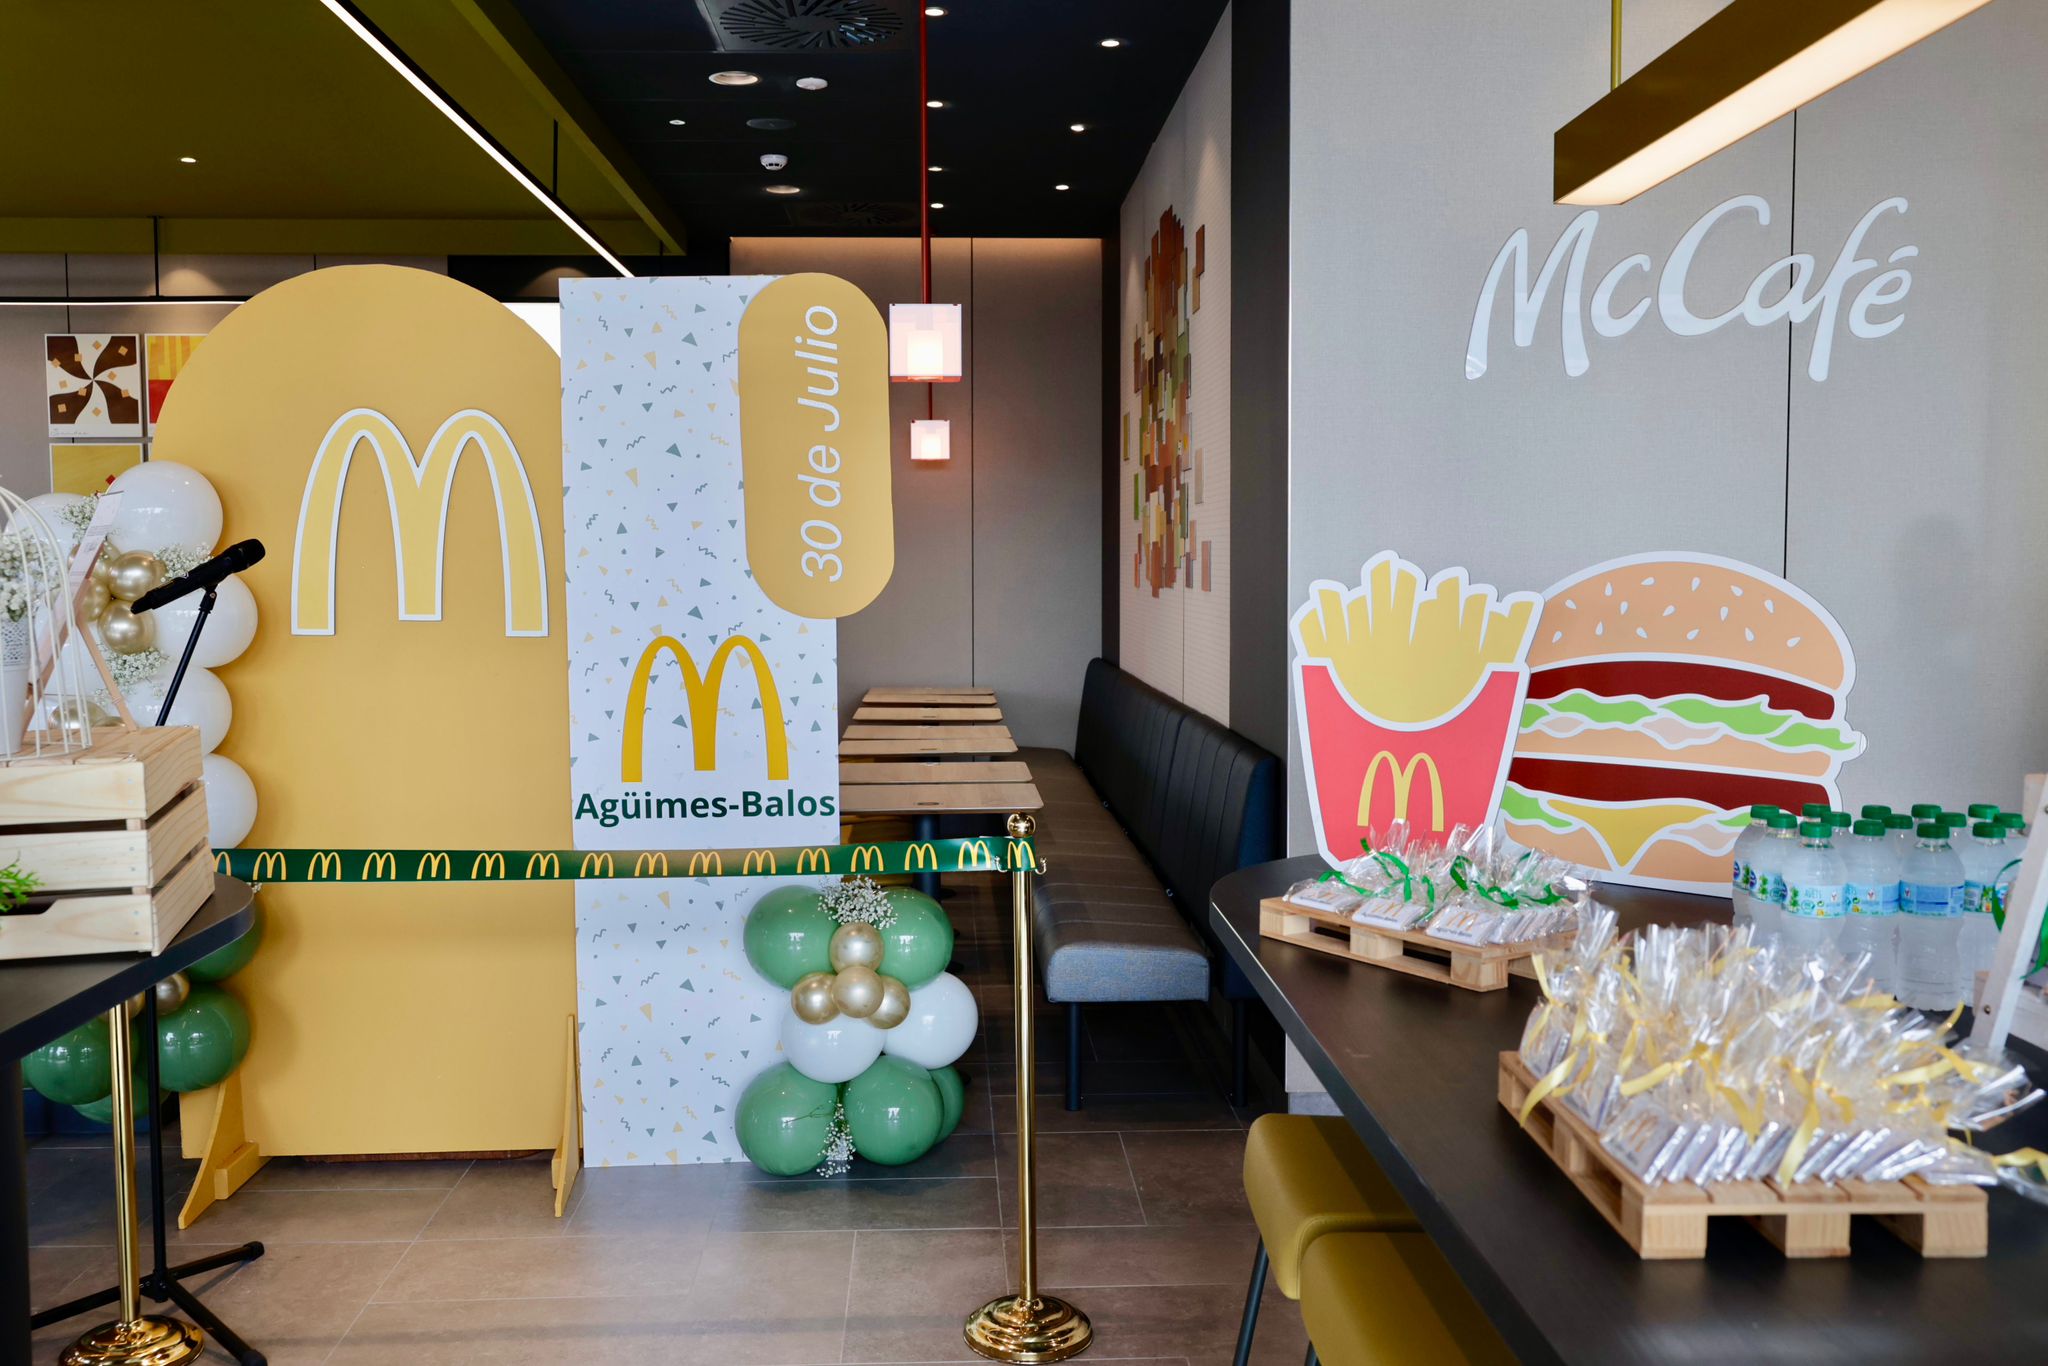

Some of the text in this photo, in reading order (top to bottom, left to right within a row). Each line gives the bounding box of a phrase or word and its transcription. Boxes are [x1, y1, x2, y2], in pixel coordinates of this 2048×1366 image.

[1465, 195, 1919, 383] McCafé
[795, 305, 844, 583] 30 de Julio
[574, 788, 837, 828] Agüimes-Balos
